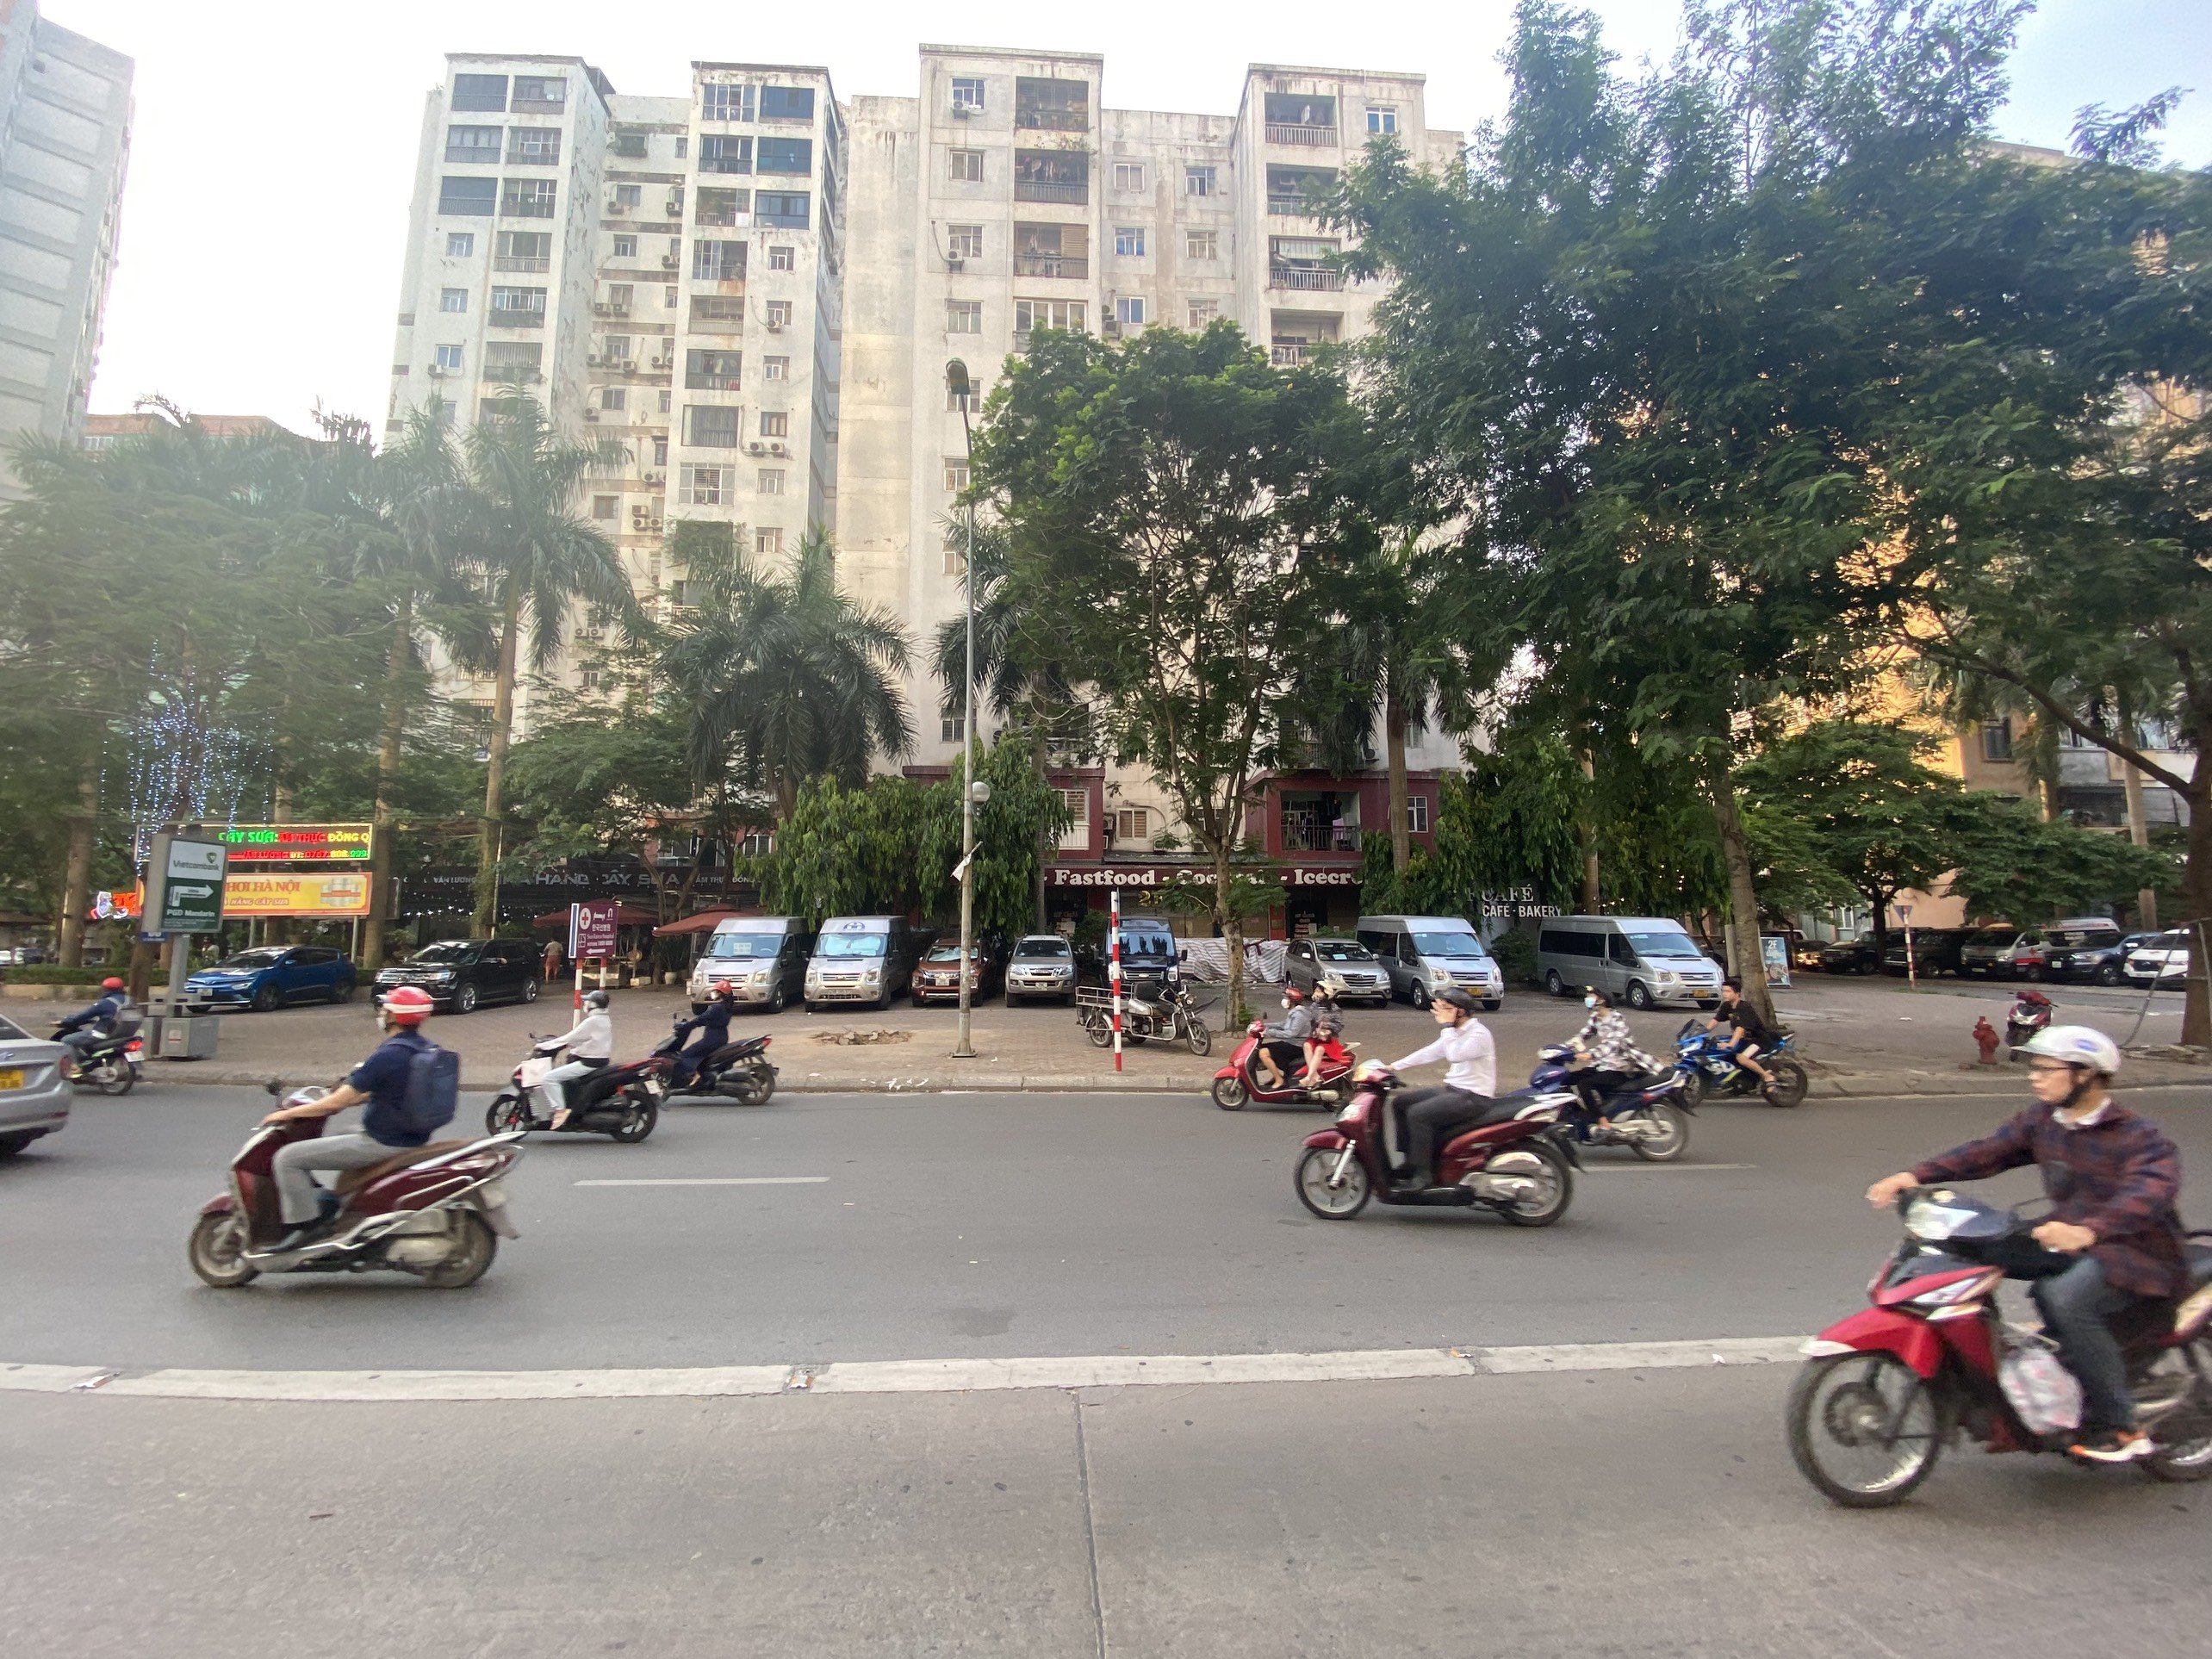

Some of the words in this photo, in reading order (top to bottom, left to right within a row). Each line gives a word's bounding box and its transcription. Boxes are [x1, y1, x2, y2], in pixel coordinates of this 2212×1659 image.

[173, 860, 220, 871] Vietcombank
[1054, 869, 1155, 885] Fastfood
[1482, 904, 1511, 917] CAFÉ
[1519, 905, 1562, 917] BAKERY
[1768, 940, 1778, 949] 2F
